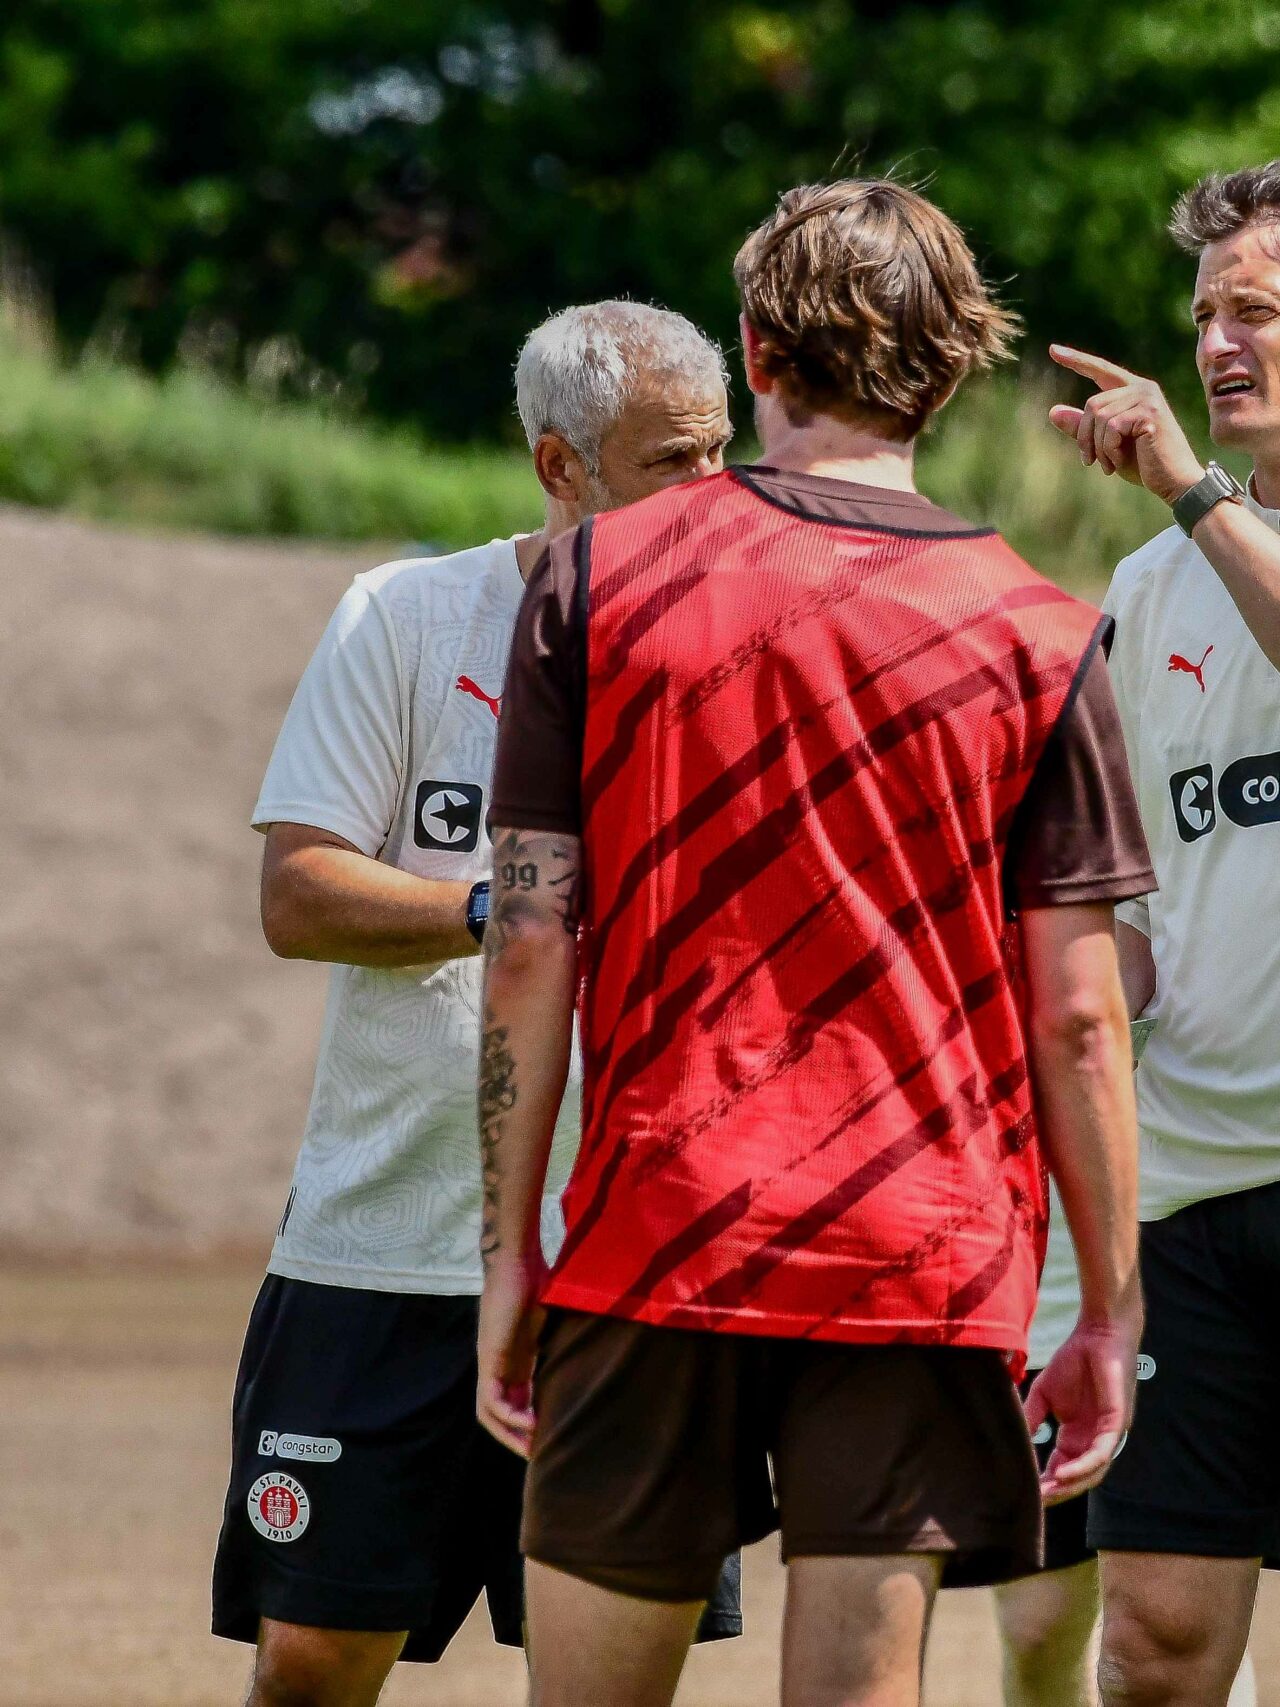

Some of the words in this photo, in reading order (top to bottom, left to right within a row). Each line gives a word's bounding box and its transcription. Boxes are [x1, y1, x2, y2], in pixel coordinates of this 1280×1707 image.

[282, 1441, 334, 1455] congstar
[250, 1488, 260, 1503] FC
[259, 1475, 275, 1489] ST.
[279, 1475, 308, 1508] PAULI
[267, 1528, 292, 1540] 1910
